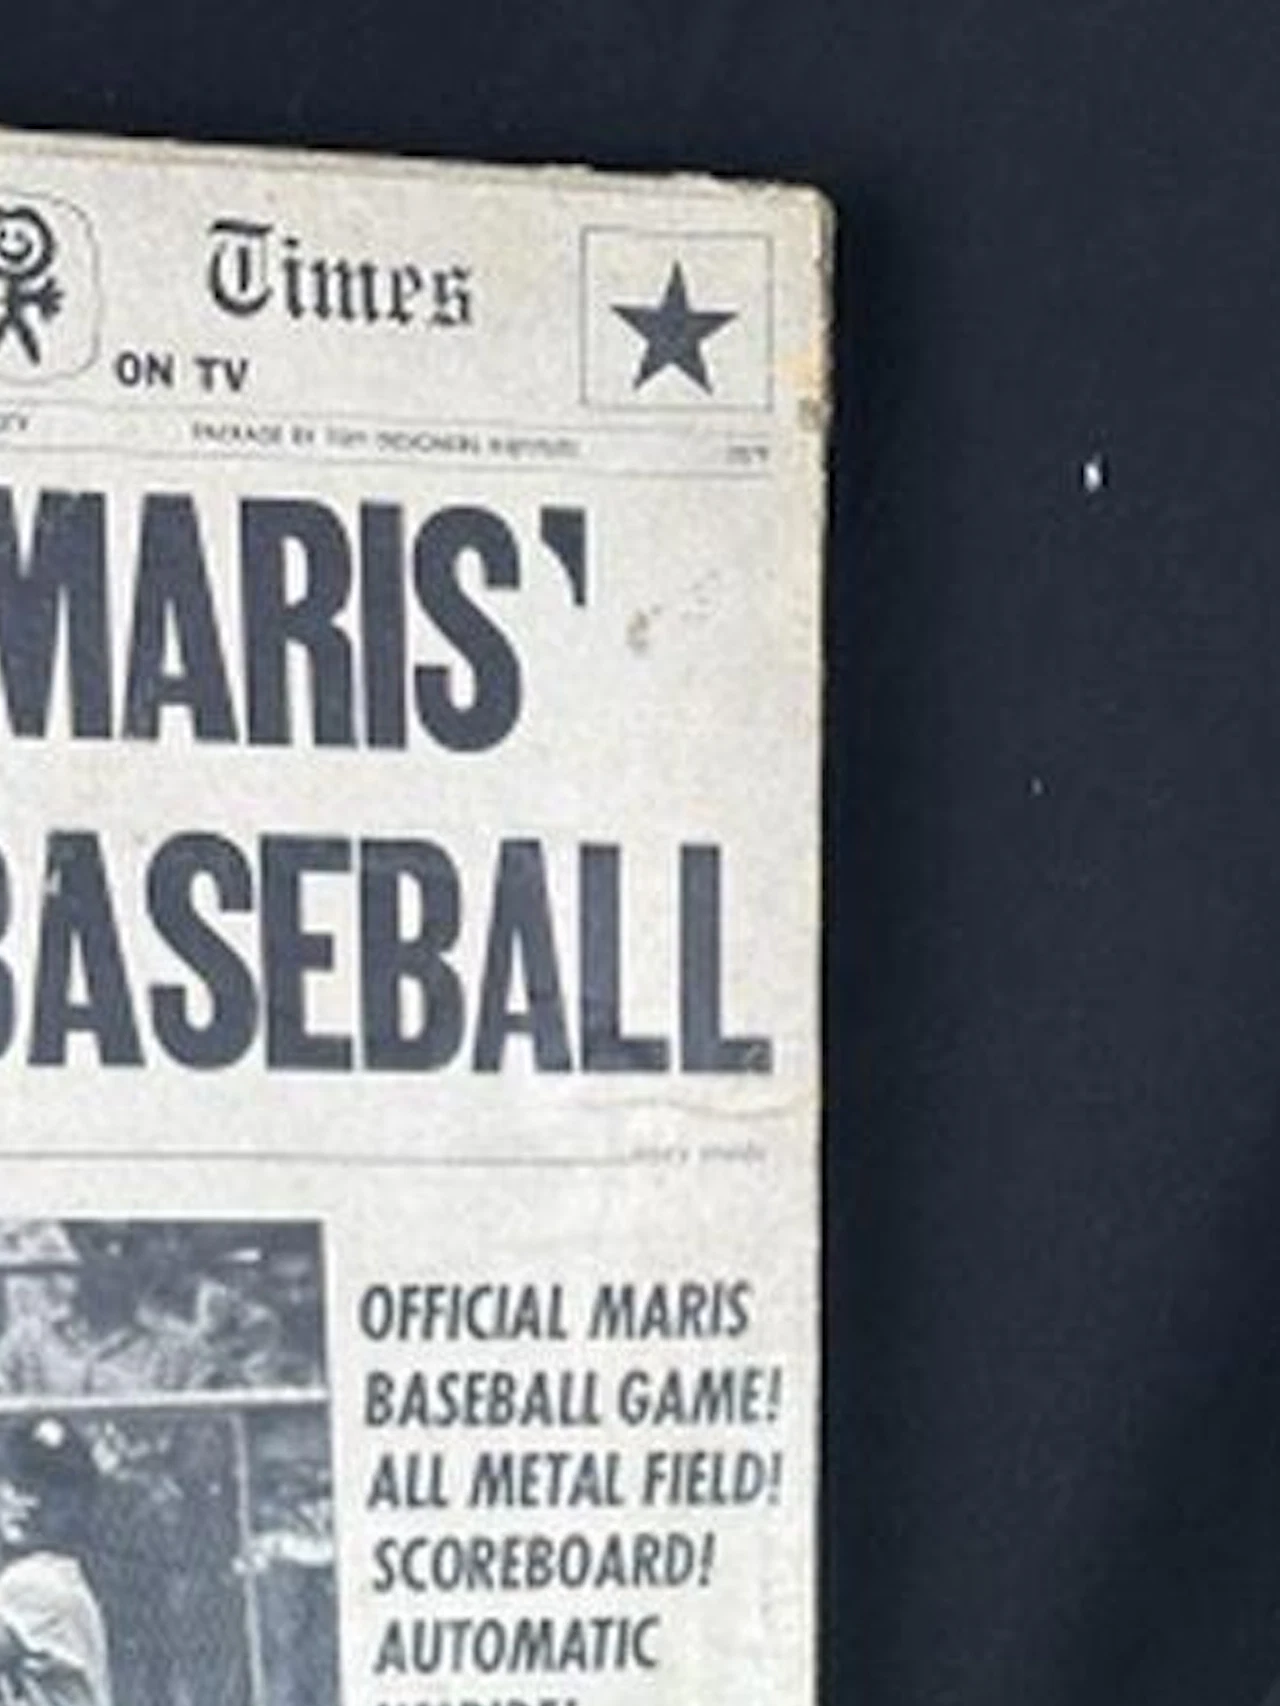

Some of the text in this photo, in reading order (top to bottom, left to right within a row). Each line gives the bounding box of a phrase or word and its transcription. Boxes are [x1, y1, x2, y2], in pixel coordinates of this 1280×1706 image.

[207, 218, 475, 329] Times
[119, 351, 250, 394] ON TV
[358, 1279, 752, 1342] OFFICIAL MARIS
[363, 1366, 784, 1429] BASEBALL GAME!
[366, 1450, 784, 1510] ALL METAL FIELD!
[372, 1533, 716, 1592] SCOREBOARD!
[373, 1615, 661, 1674] AUTOMATIC
